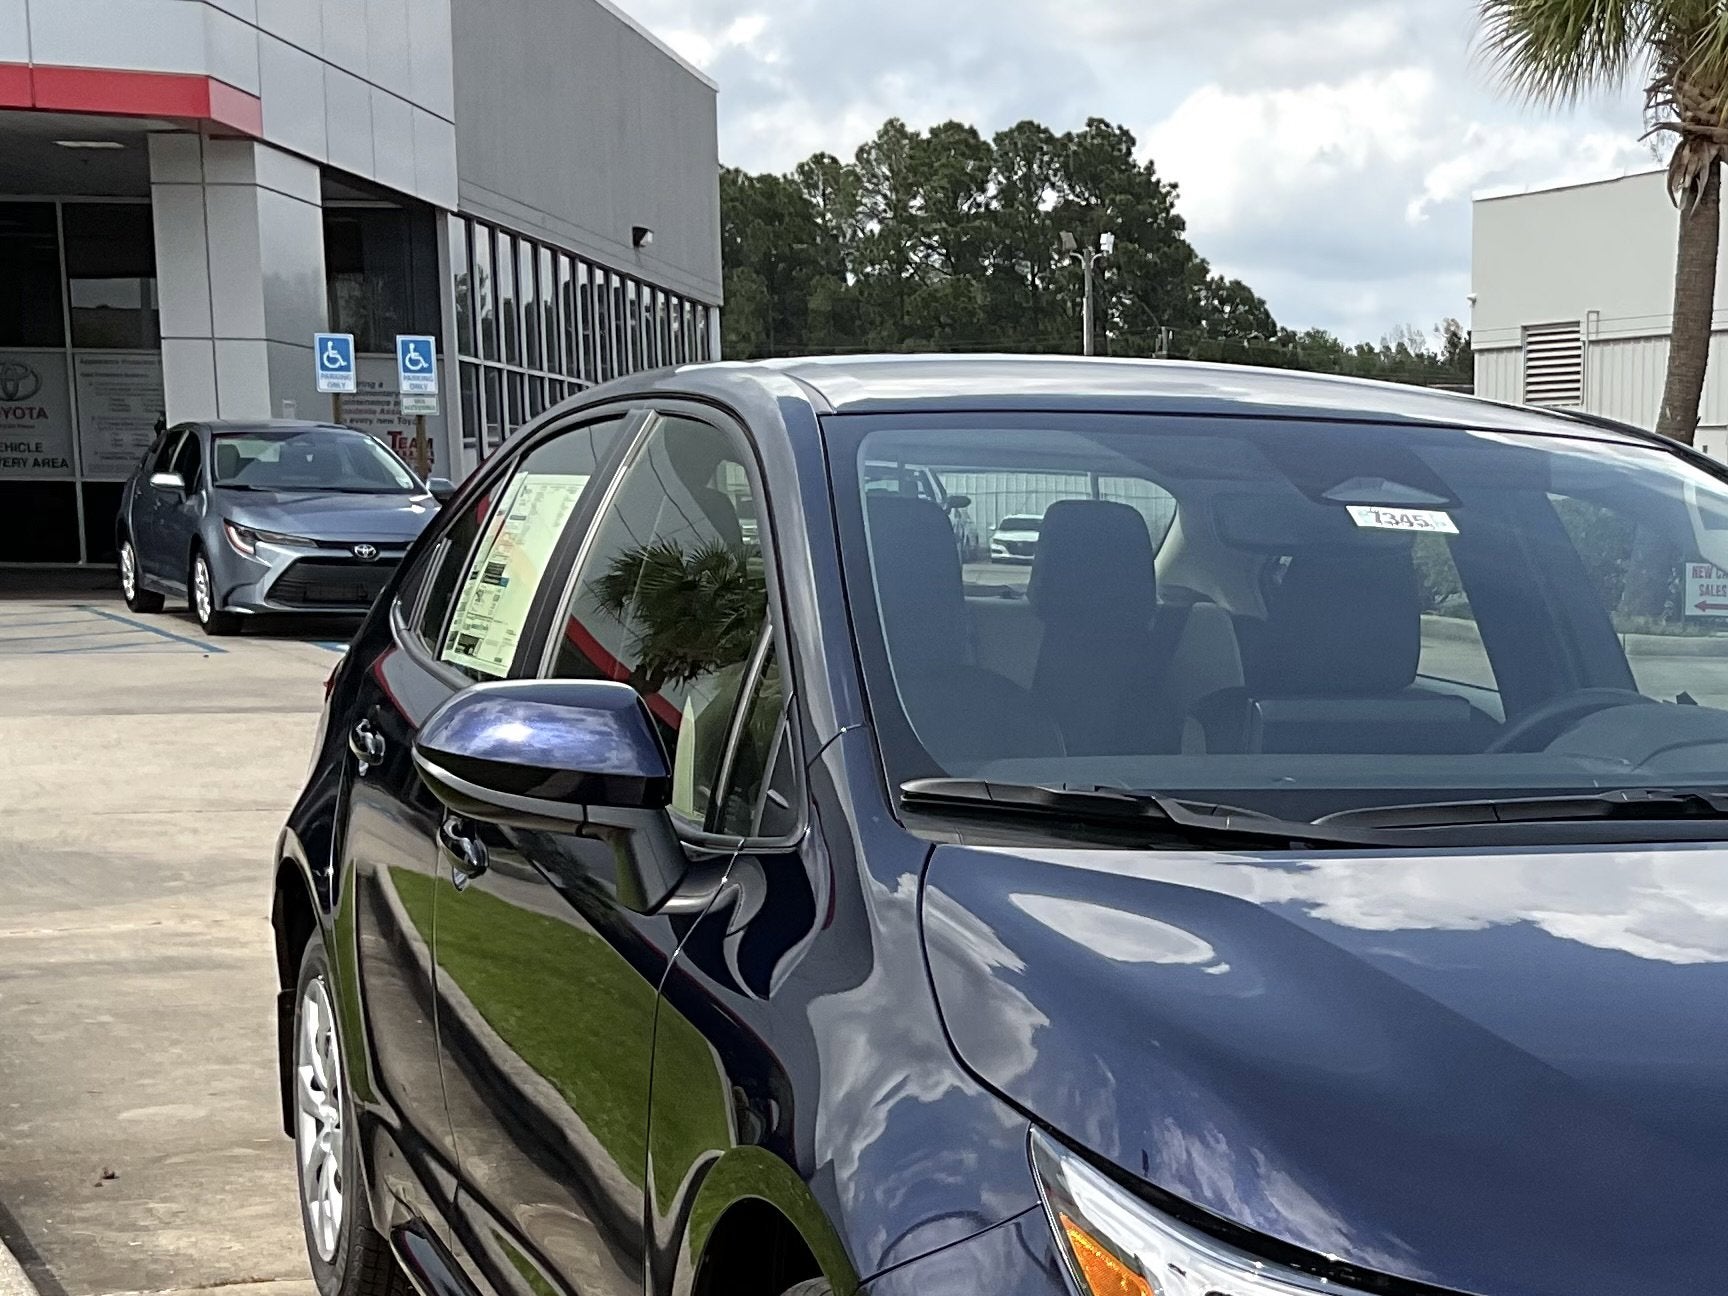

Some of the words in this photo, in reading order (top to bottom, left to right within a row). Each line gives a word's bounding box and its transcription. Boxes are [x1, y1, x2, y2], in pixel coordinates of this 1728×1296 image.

[327, 381, 346, 389] ONLY
[0, 406, 48, 420] YOTA
[0, 458, 27, 468] ERY
[32, 457, 69, 468] AREA
[1692, 566, 1713, 579] NEW
[1698, 584, 1727, 597] SALES
